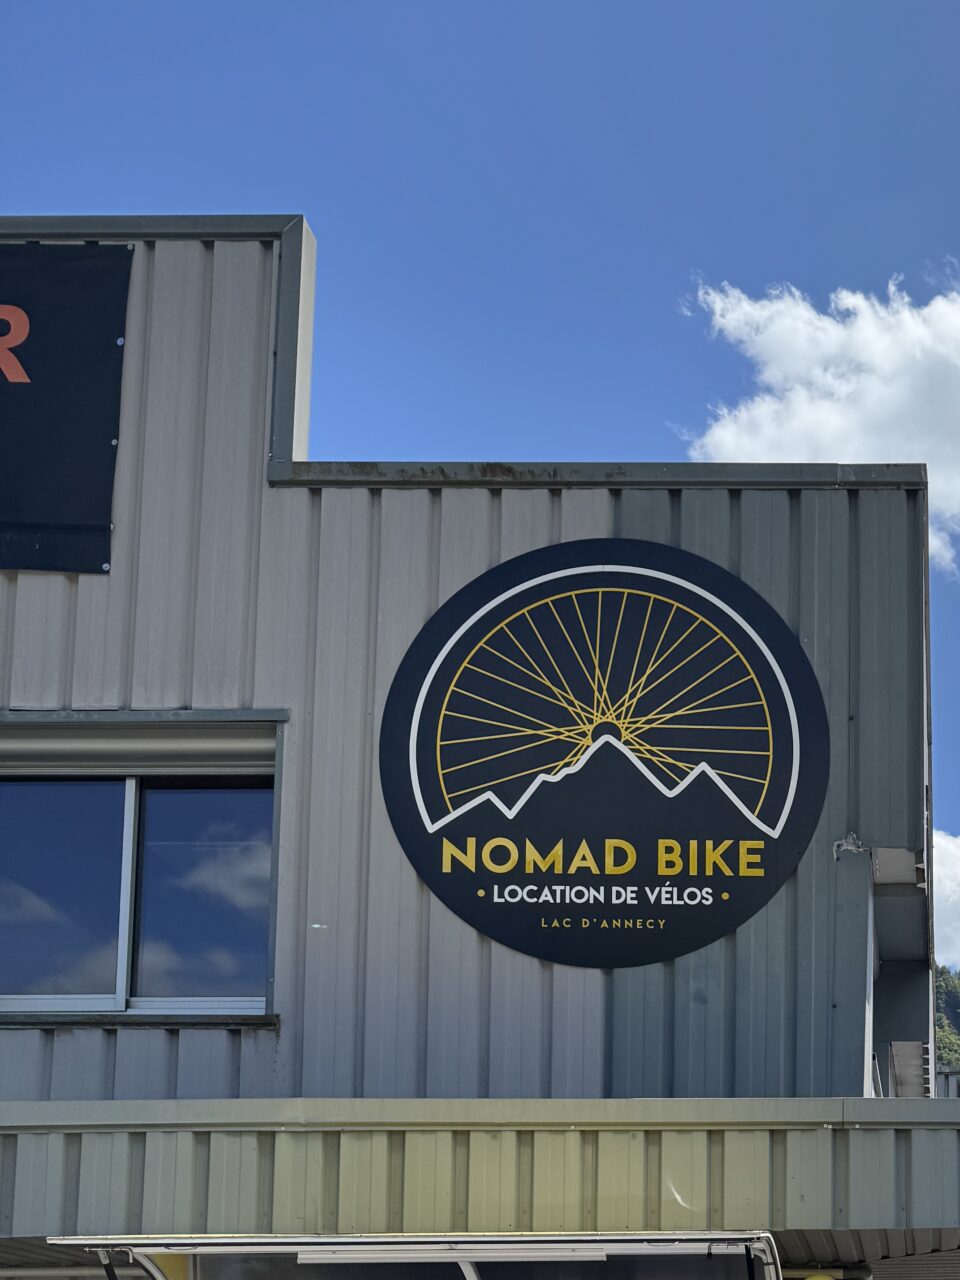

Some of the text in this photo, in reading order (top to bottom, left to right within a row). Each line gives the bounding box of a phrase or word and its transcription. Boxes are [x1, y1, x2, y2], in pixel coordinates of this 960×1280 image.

[441, 836, 766, 877] NOMAD BIKE
[493, 881, 714, 906] LOCATION DE VÉLOS
[541, 917, 667, 930] LAC D'ANNECY
